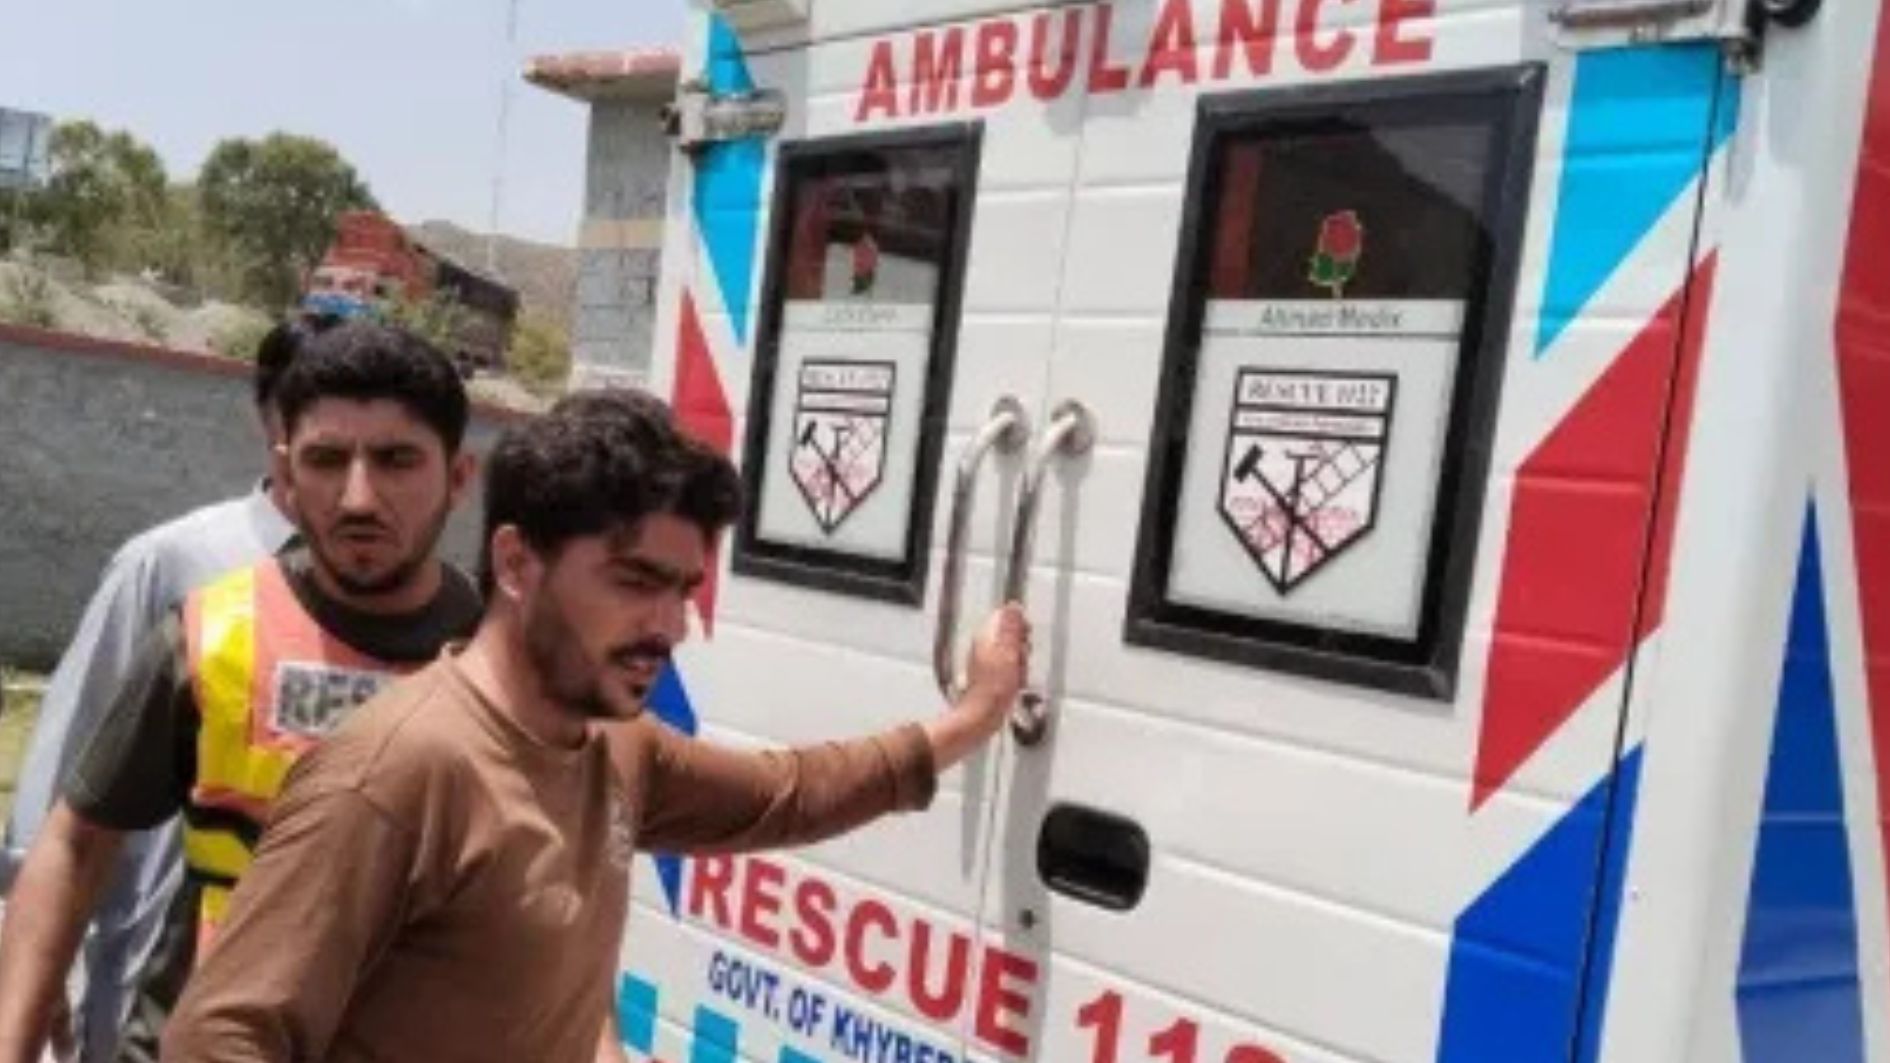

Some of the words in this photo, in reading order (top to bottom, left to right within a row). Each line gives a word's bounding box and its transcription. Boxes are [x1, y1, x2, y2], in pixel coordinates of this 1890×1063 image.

[853, 0, 1436, 122] AMBULANCE
[689, 849, 1038, 1058] RESCUE
[708, 951, 781, 1021] GOVT.
[788, 987, 825, 1037] OF
[831, 1004, 956, 1063] KHYB
